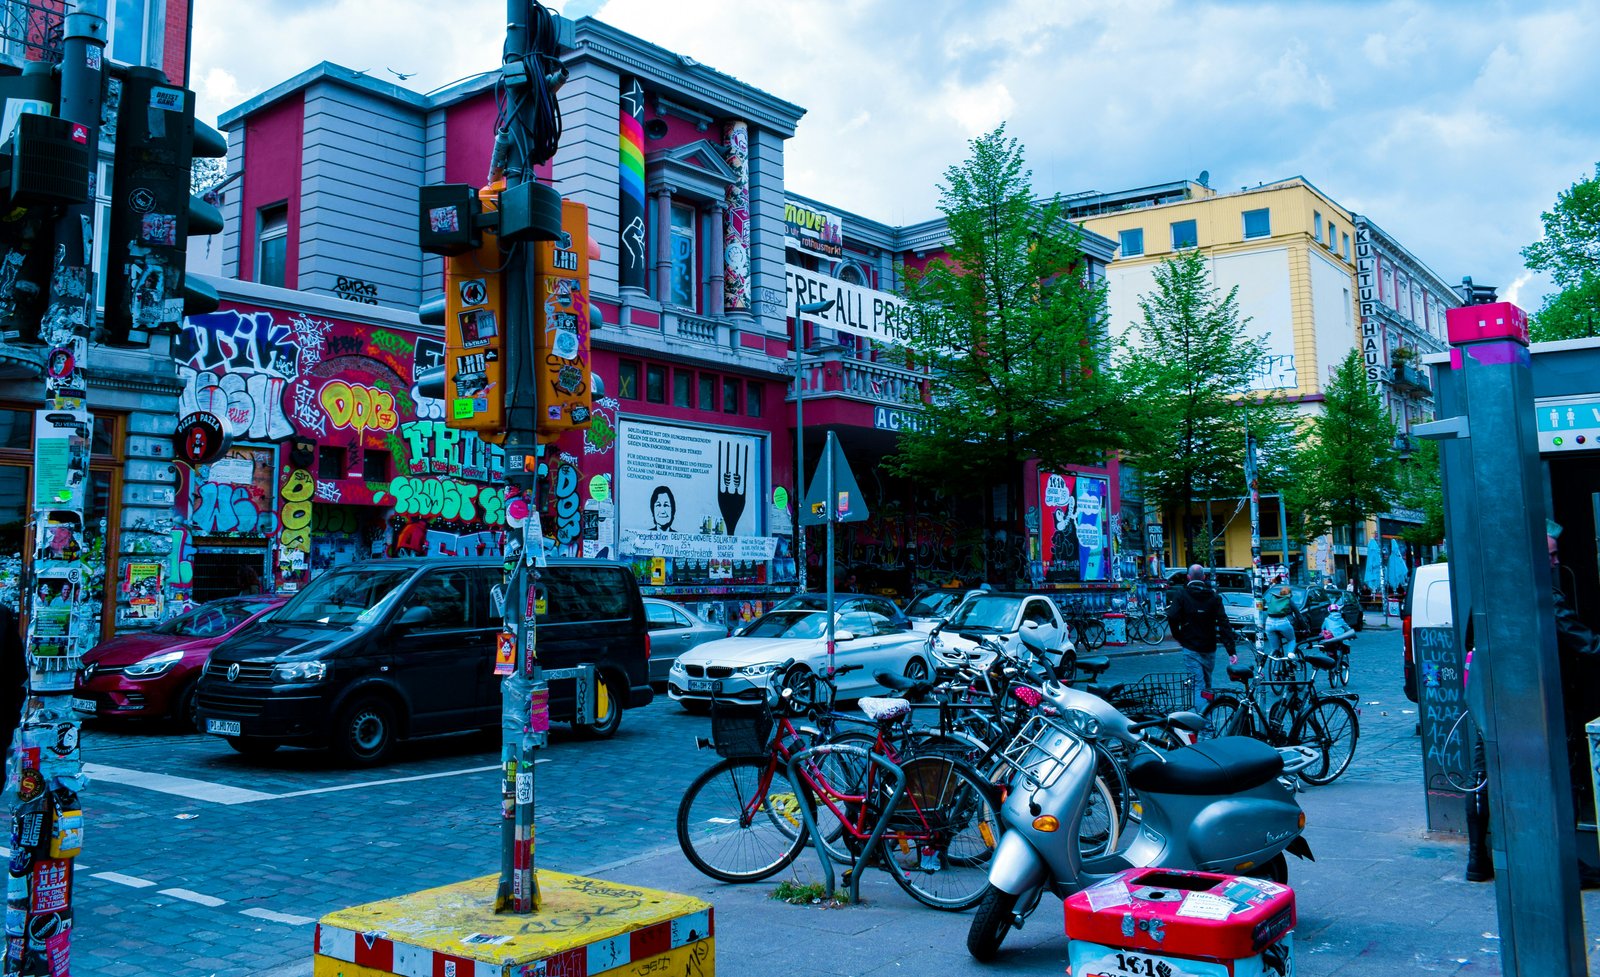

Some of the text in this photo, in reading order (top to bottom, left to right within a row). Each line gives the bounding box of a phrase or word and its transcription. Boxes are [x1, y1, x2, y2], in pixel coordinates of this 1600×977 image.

[836, 287, 868, 330] ALL
[177, 414, 220, 433] PIZZA PAZZA
[19, 813, 32, 847] REGGAE
[37, 890, 49, 898] THE
